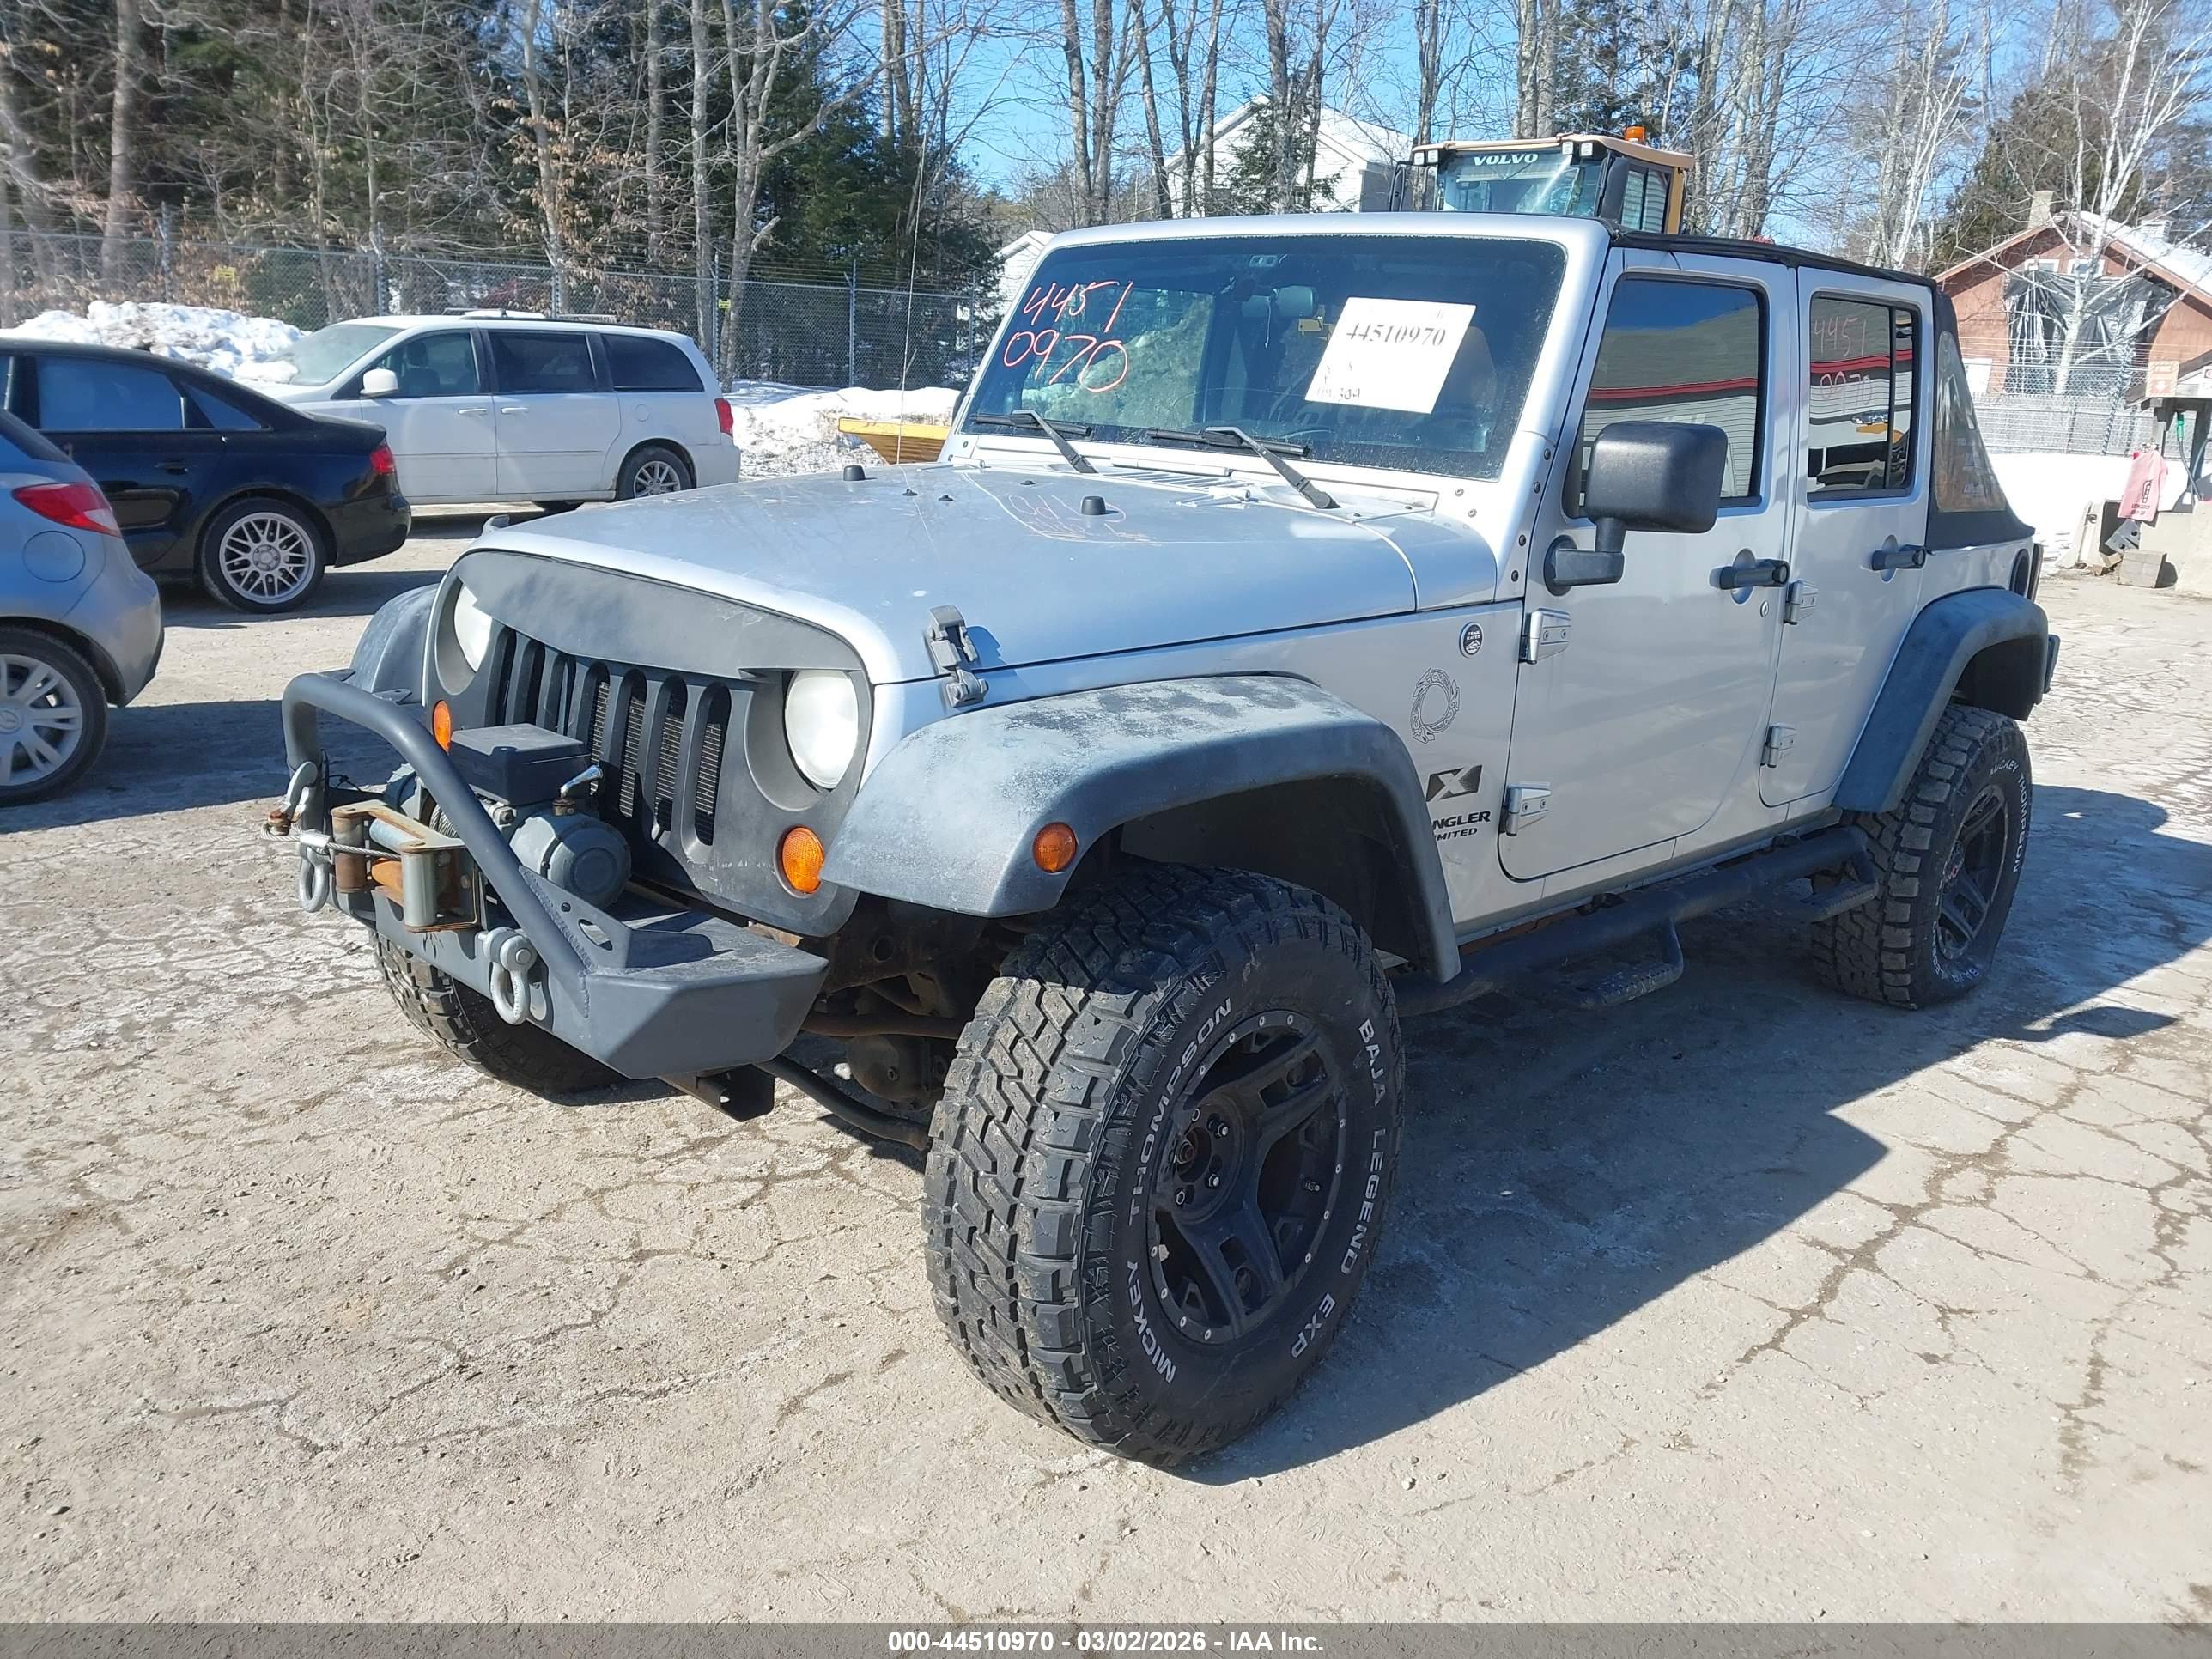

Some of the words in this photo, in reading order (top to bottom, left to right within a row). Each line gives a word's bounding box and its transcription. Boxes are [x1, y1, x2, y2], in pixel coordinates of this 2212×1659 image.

[1474, 153, 1539, 166] VOLVO
[1023, 281, 1133, 333] 4451
[1346, 322, 1446, 347] 44510970
[1003, 329, 1127, 392] 0970
[1813, 317, 1868, 357] 4451
[1432, 811, 1491, 830] NGLER
[1435, 828, 1478, 842] MITED
[1358, 1018, 1387, 1107] BAJA
[1128, 997, 1231, 1227] THOMPSON
[1340, 1127, 1386, 1276] LEGEND
[1127, 1260, 1177, 1383] MICKEY
[1290, 1291, 1336, 1358] EXP
